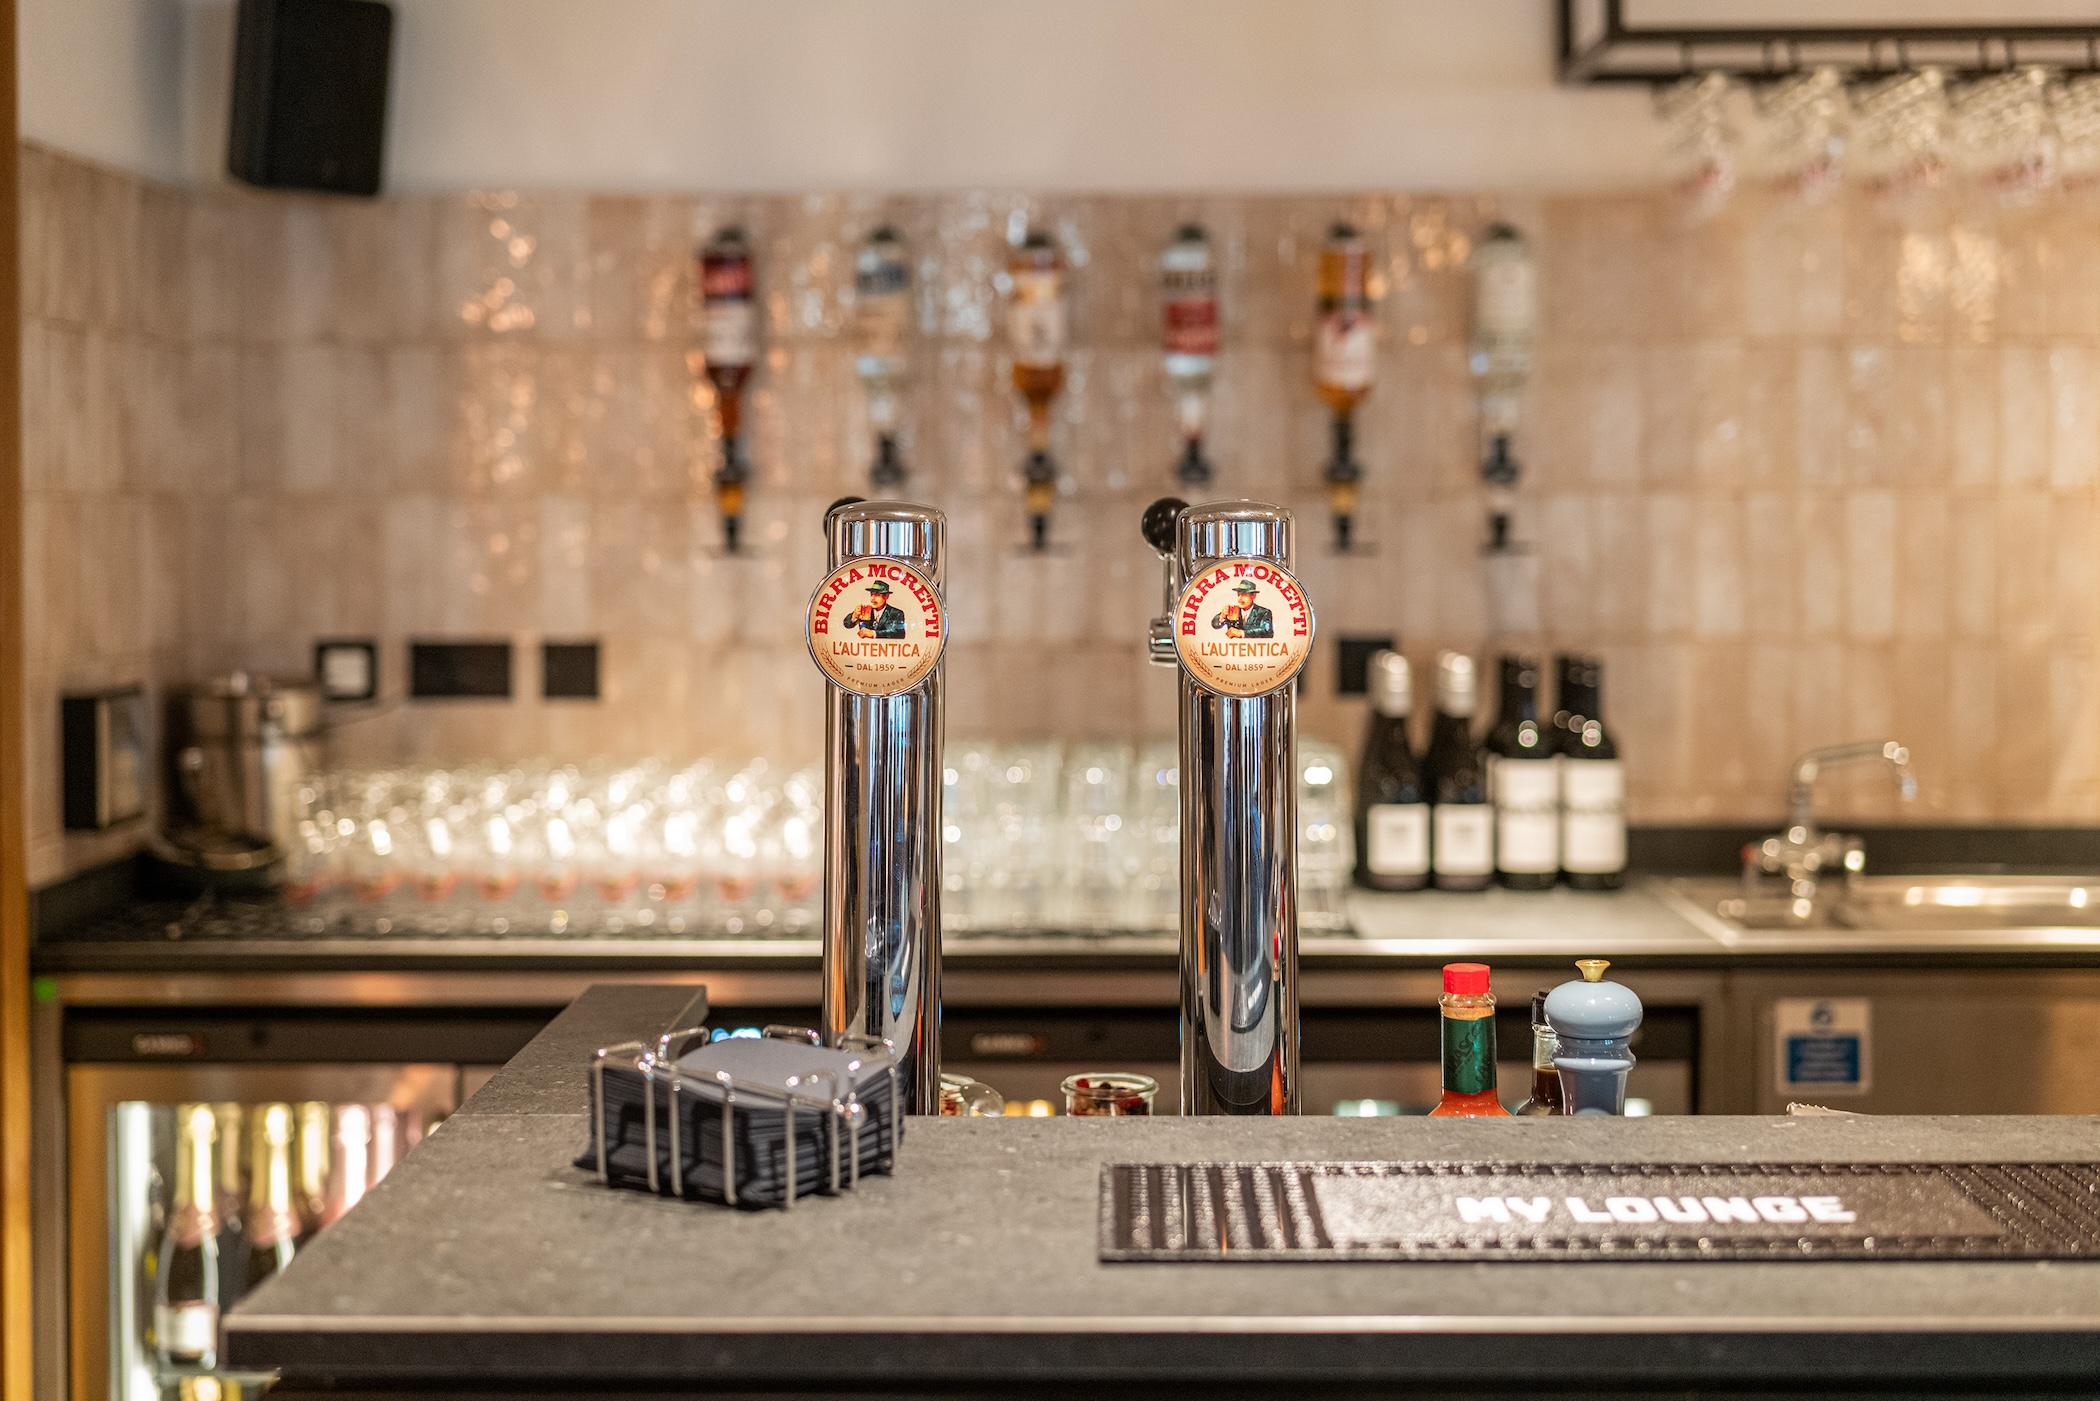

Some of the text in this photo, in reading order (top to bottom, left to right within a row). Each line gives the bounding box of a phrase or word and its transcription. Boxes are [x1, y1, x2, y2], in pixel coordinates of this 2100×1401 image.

[815, 564, 939, 638] BIRRA MORETTI
[1182, 564, 1307, 637] BIRRA MORETTI
[832, 641, 920, 657] L'AUTENTICA
[1201, 642, 1288, 657] L'AUTENTICA
[856, 663, 895, 671] DAL 1859
[1244, 663, 1264, 671] 1859
[1455, 1195, 1857, 1224] MY LOUNGE
